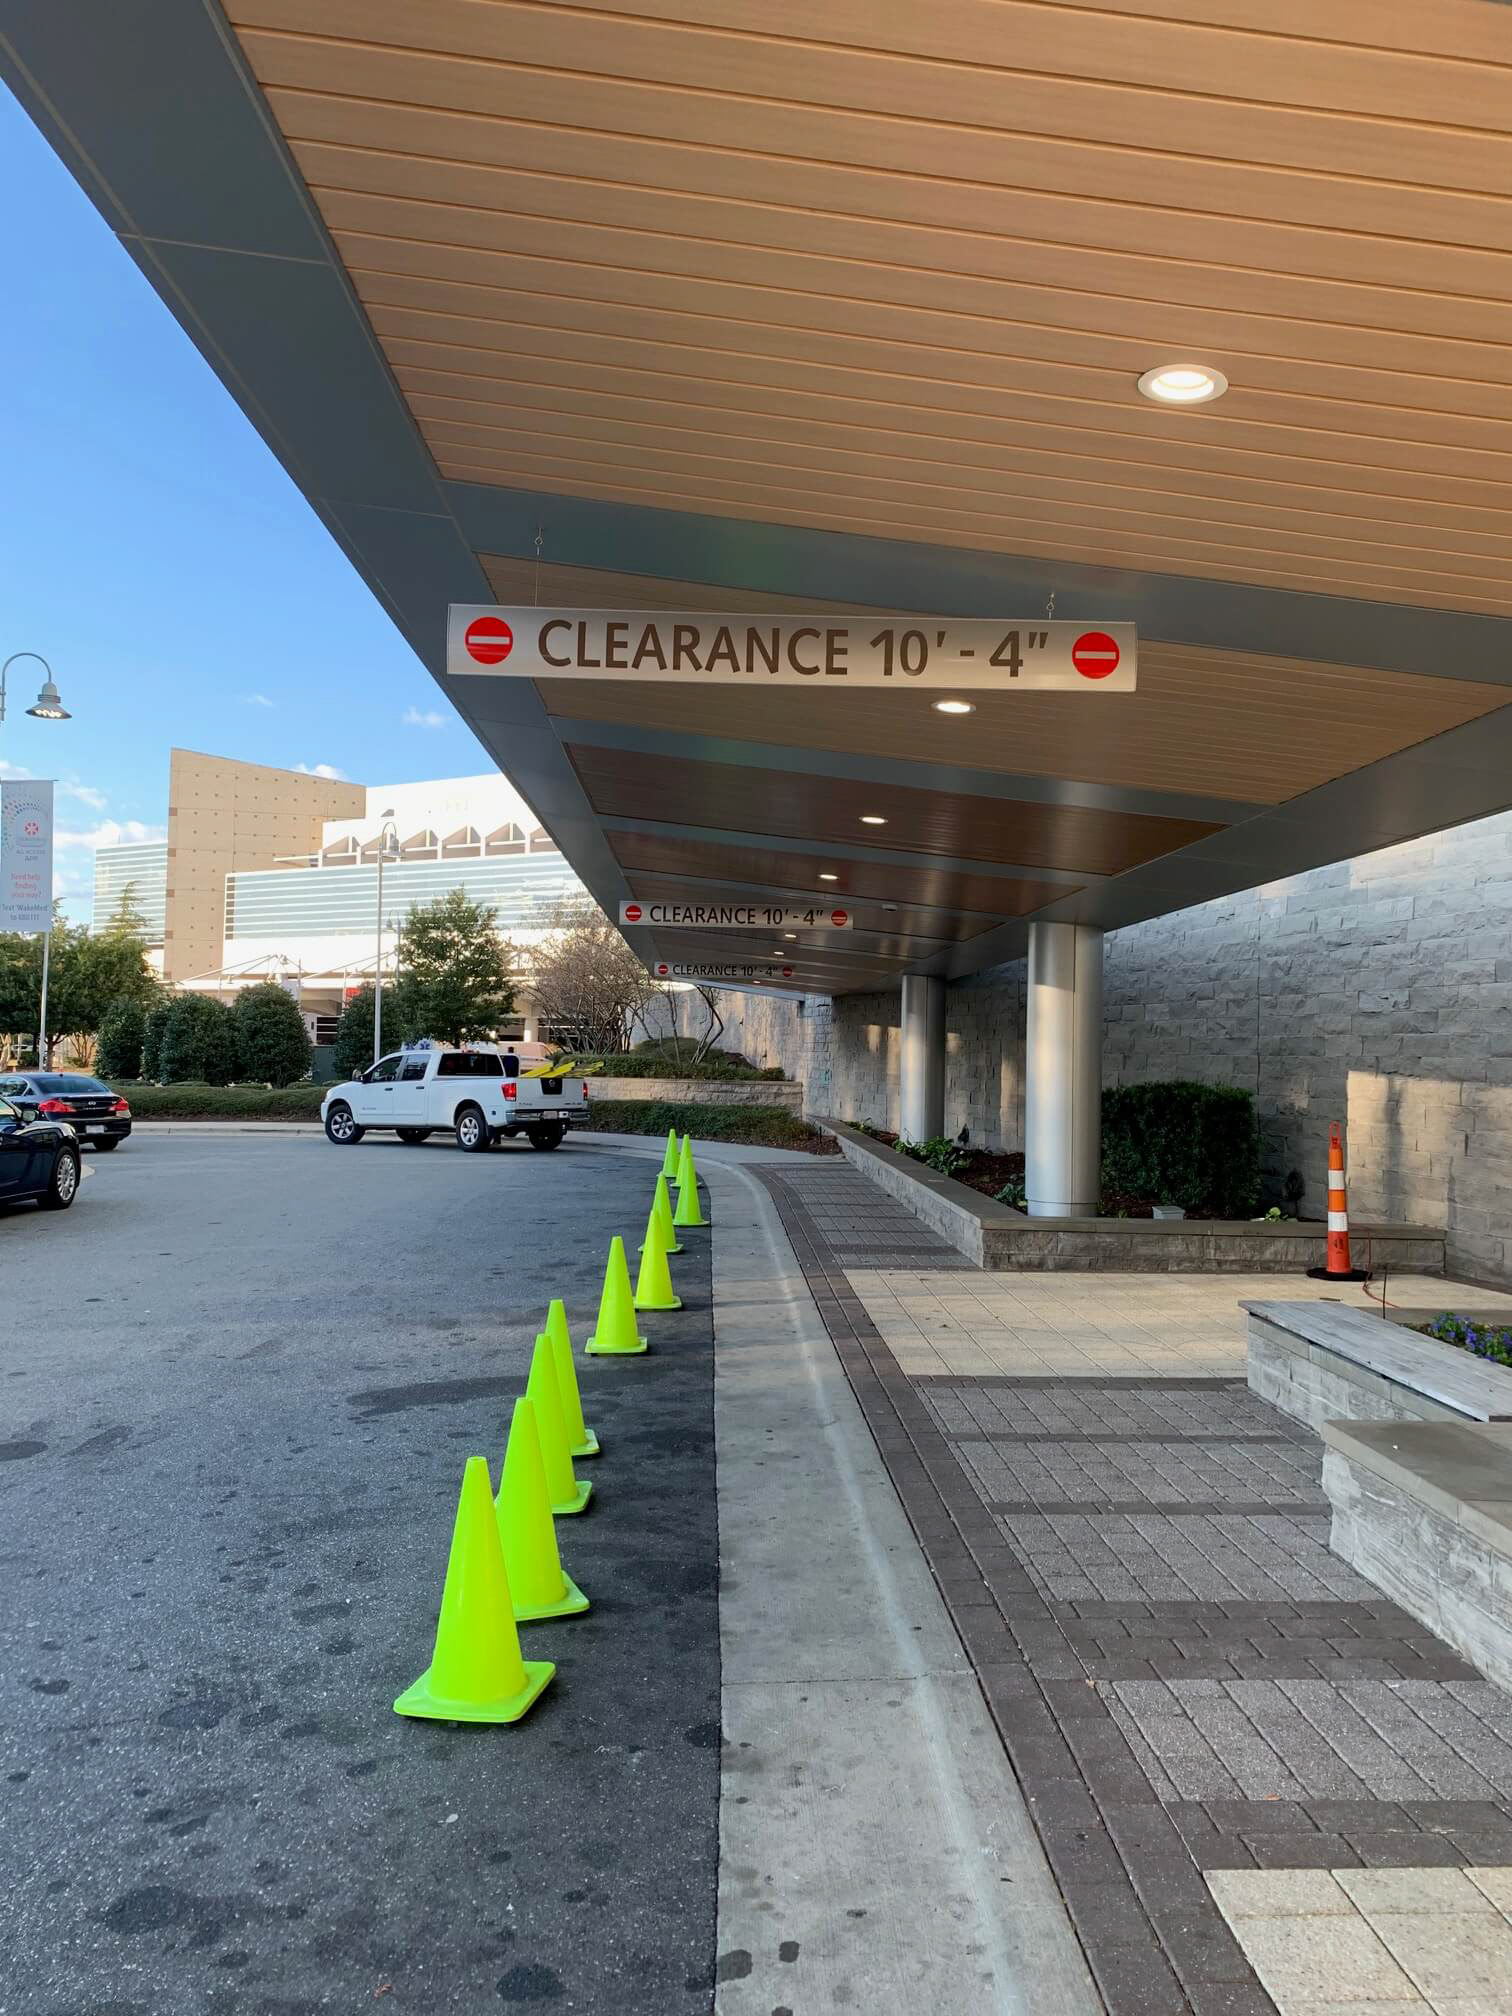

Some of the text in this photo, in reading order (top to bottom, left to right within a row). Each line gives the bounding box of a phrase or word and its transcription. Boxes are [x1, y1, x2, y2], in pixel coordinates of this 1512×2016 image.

[538, 618, 849, 676] CLEARANCE
[650, 905, 756, 925] CLEARANCE
[672, 964, 738, 976] CLEARANCE
